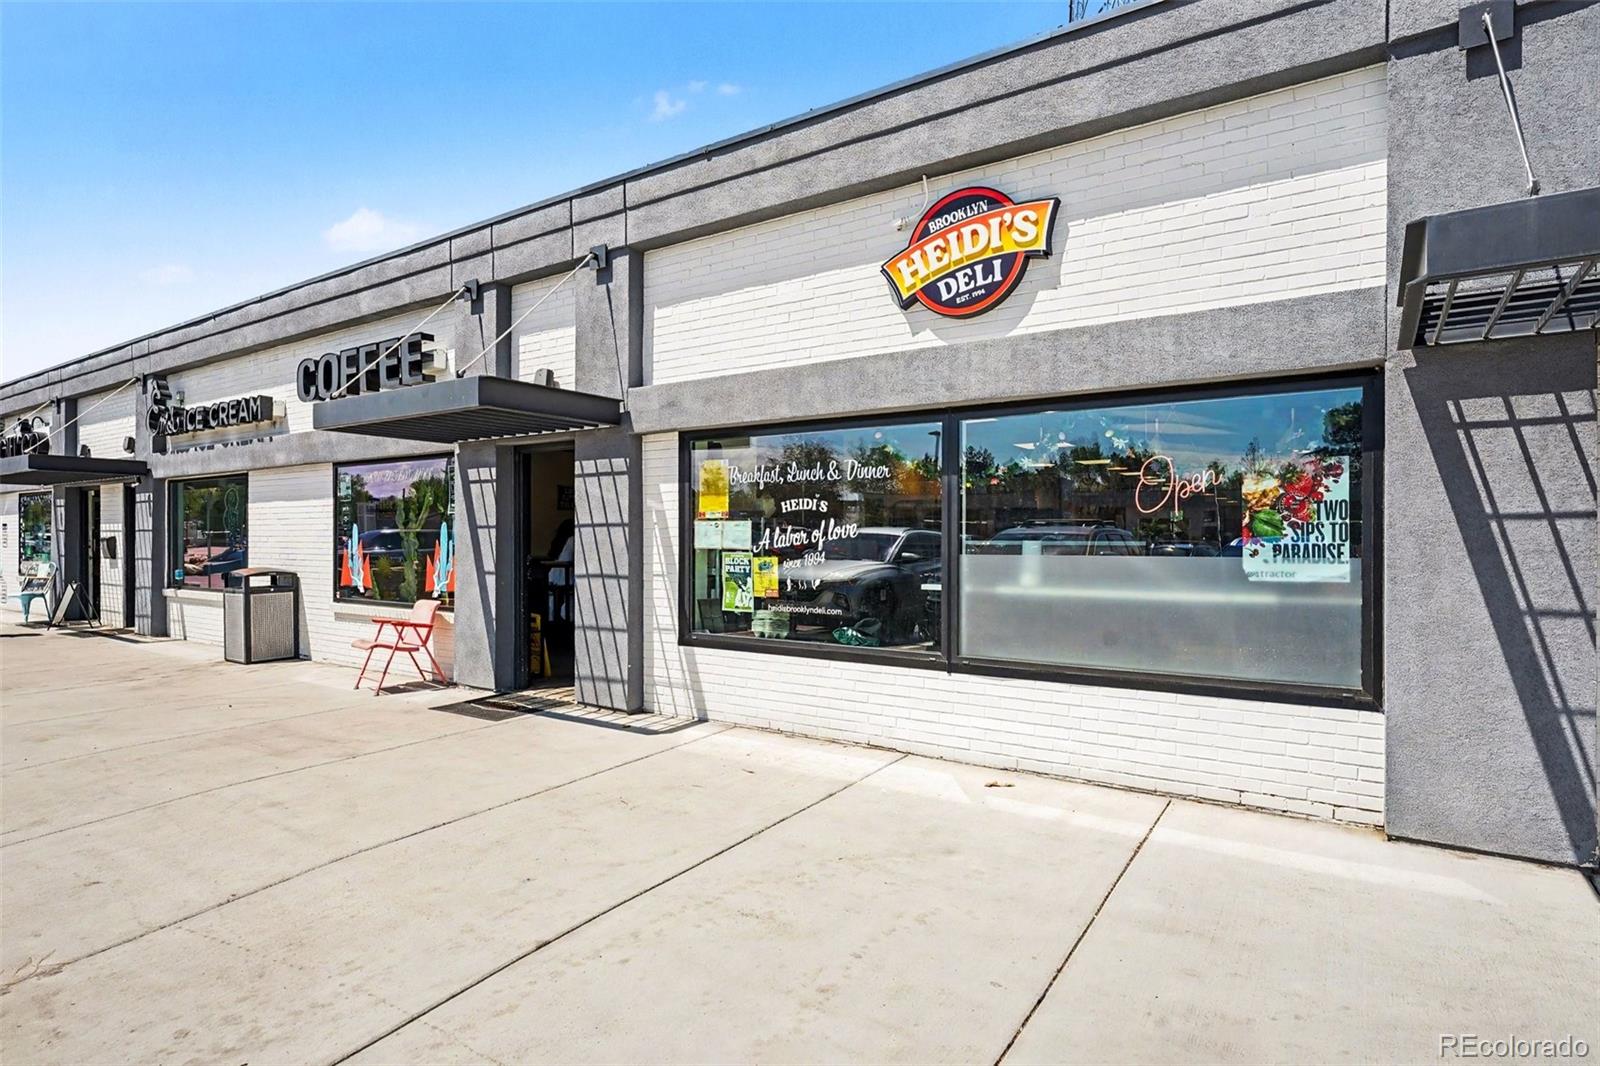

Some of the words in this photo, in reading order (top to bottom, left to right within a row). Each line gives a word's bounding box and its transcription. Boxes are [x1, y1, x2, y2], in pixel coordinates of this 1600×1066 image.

[928, 200, 988, 234] BROOKLYN
[896, 210, 1038, 288] HEIDI'S
[937, 259, 1003, 301] DELI
[956, 293, 972, 304] EST.
[297, 332, 425, 402] COFFEE
[183, 405, 205, 431] ICE
[209, 395, 262, 427] CREAM
[729, 465, 784, 490] Breakfast,
[787, 461, 825, 483] Lunch
[827, 460, 842, 481] &
[844, 459, 892, 481] Dinner
[1135, 455, 1223, 516] Open
[1314, 499, 1349, 521] TWO
[753, 528, 771, 553] A
[774, 525, 809, 548] labor
[811, 520, 826, 551] of
[828, 518, 859, 541] love
[1287, 520, 1325, 543] SIPS
[1329, 521, 1349, 543] TO
[725, 557, 749, 565] BLOCK
[783, 558, 801, 570] since
[804, 551, 826, 566] 1994
[1273, 543, 1349, 564] PARADISE.
[725, 565, 750, 573] PARTY
[768, 604, 843, 615] heidisbrooklyndeli.com
